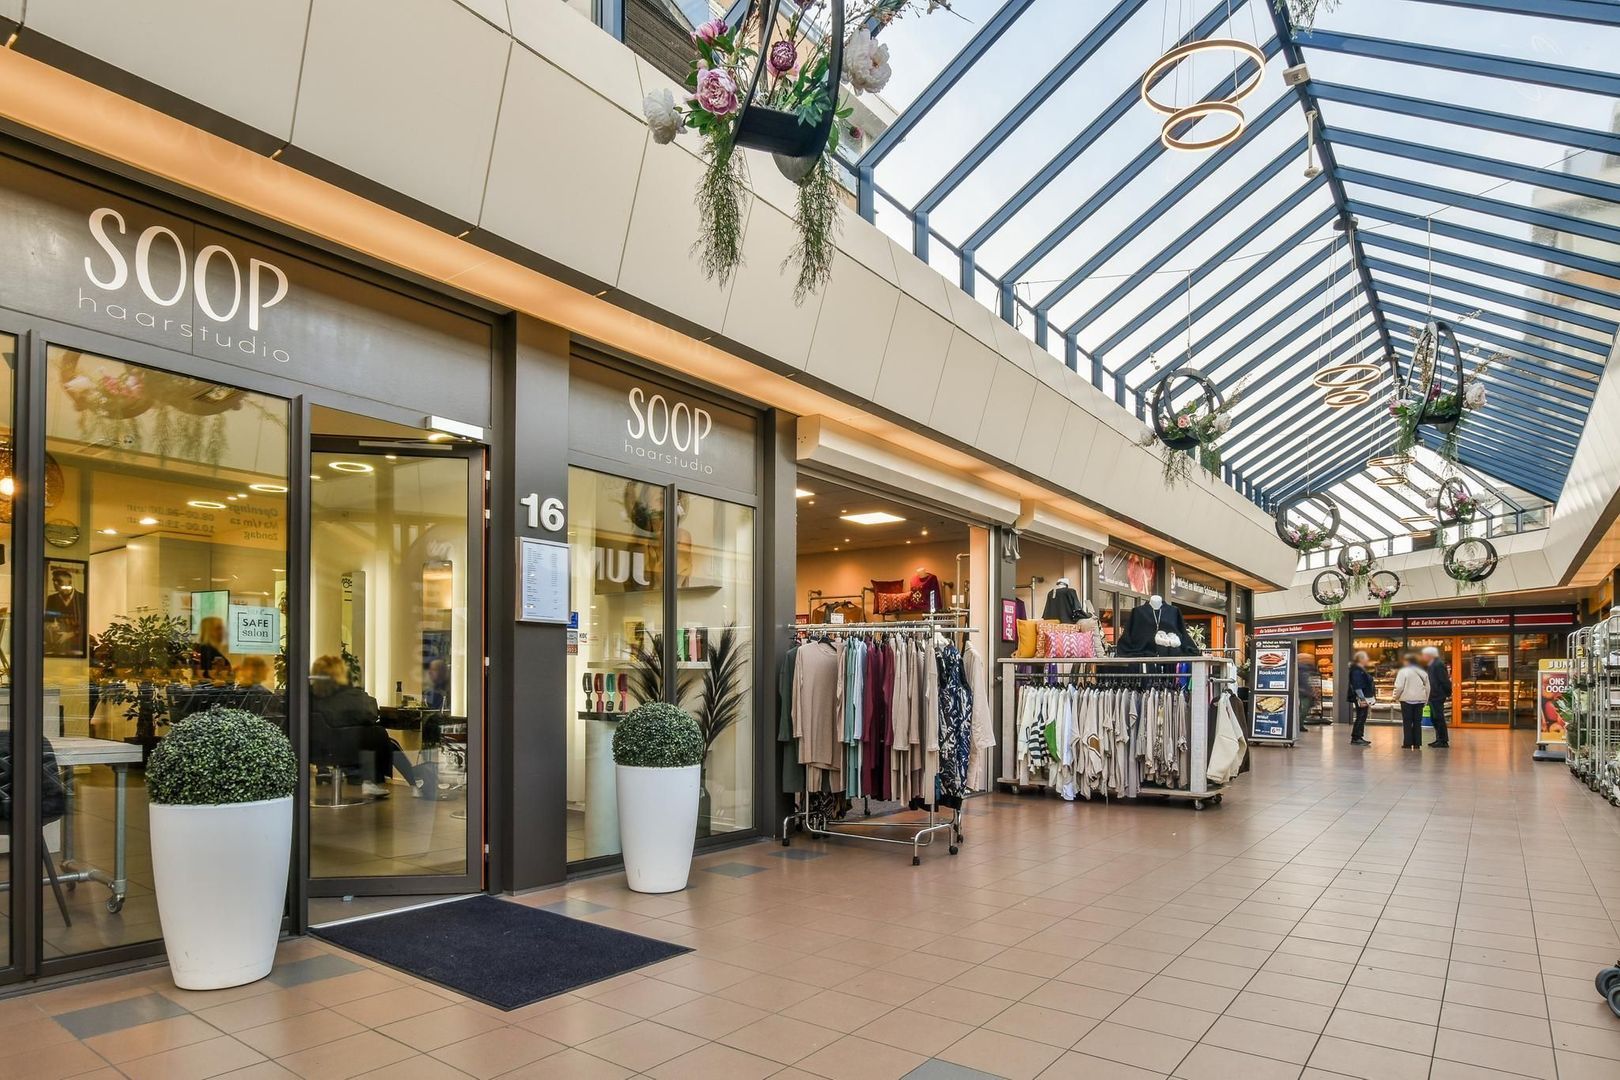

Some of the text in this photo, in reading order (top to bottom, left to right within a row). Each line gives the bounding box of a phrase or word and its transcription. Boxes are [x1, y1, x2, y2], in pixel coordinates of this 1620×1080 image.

[84, 207, 289, 331] SOOP
[78, 287, 290, 363] haarstudio
[627, 387, 712, 456] SOOP
[624, 439, 713, 475] haarstudio
[520, 493, 565, 532] 16
[242, 618, 269, 628] SAFE
[242, 628, 269, 638] salon
[1549, 677, 1565, 686] ONS
